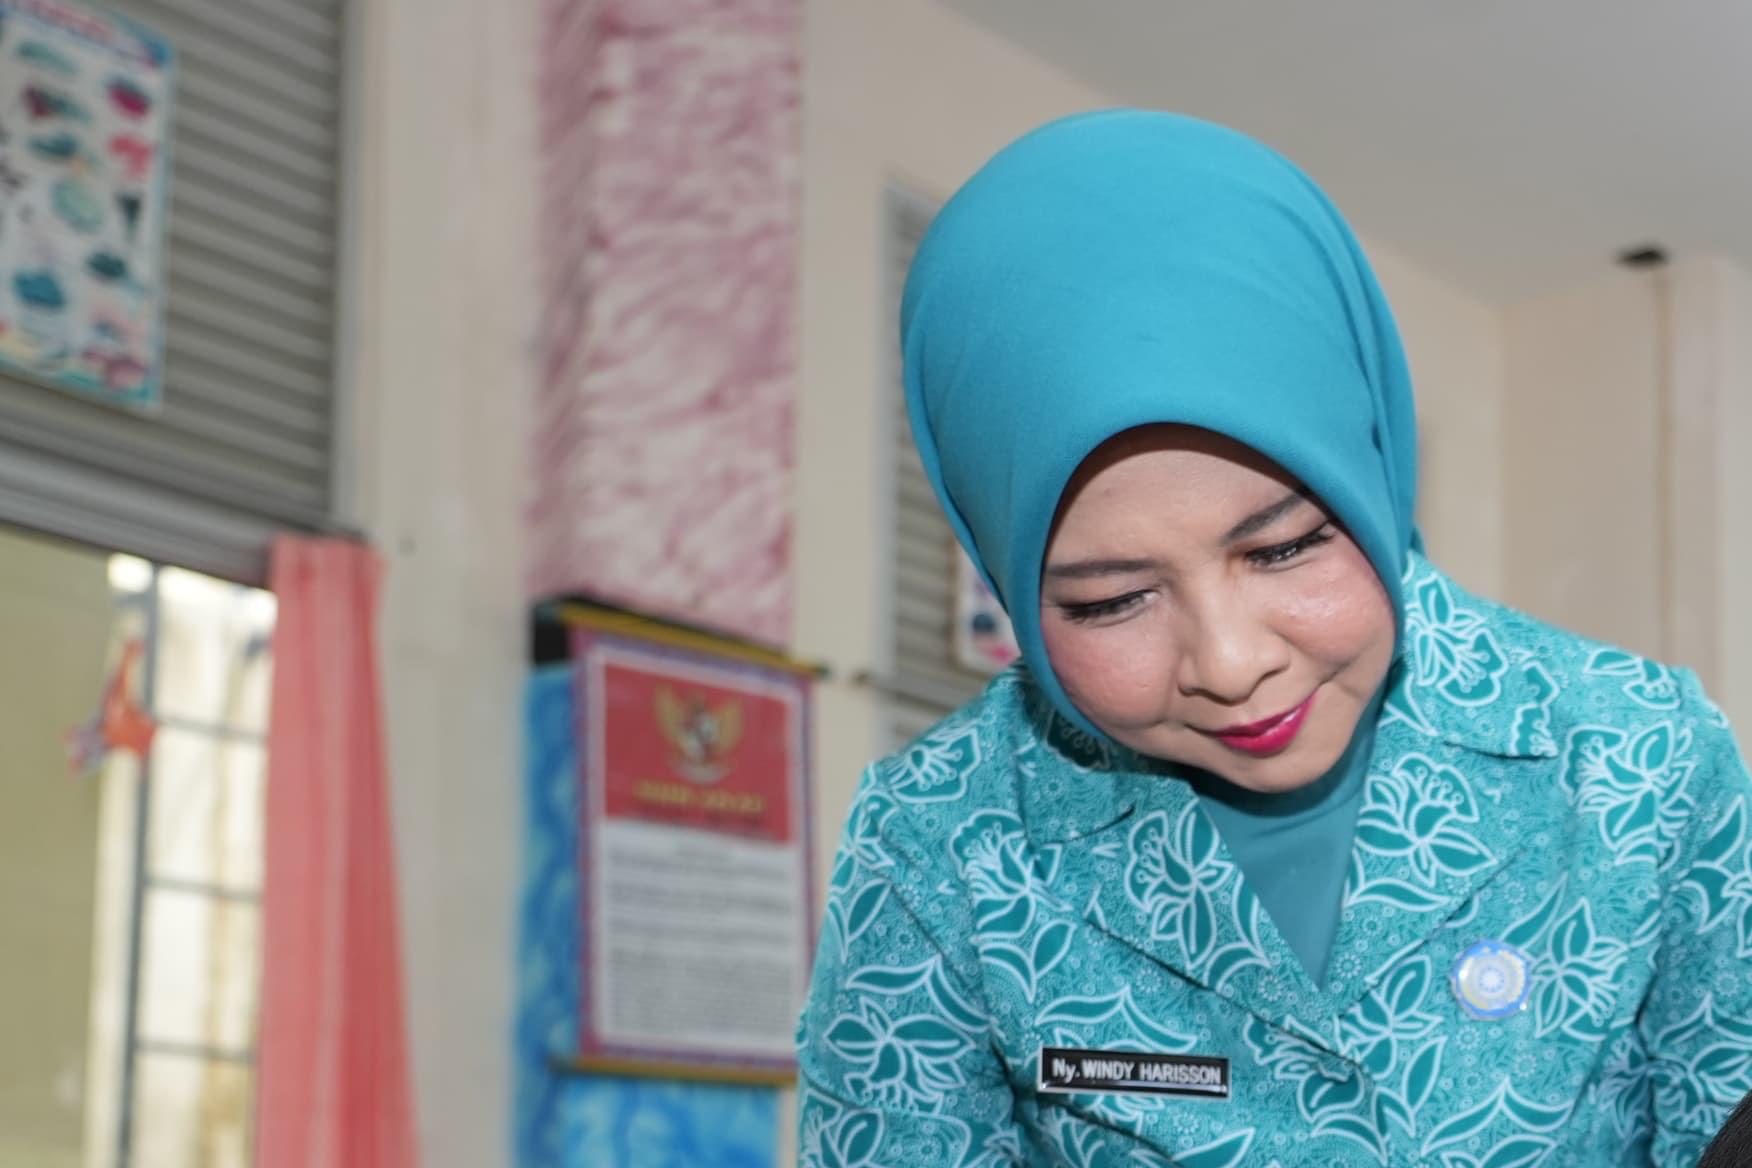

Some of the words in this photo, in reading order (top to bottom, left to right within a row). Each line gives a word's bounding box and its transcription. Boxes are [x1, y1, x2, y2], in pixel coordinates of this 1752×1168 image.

[1052, 1057, 1081, 1083] Ny.
[1081, 1059, 1135, 1080] WINDY
[1139, 1063, 1221, 1084] HARISSON
